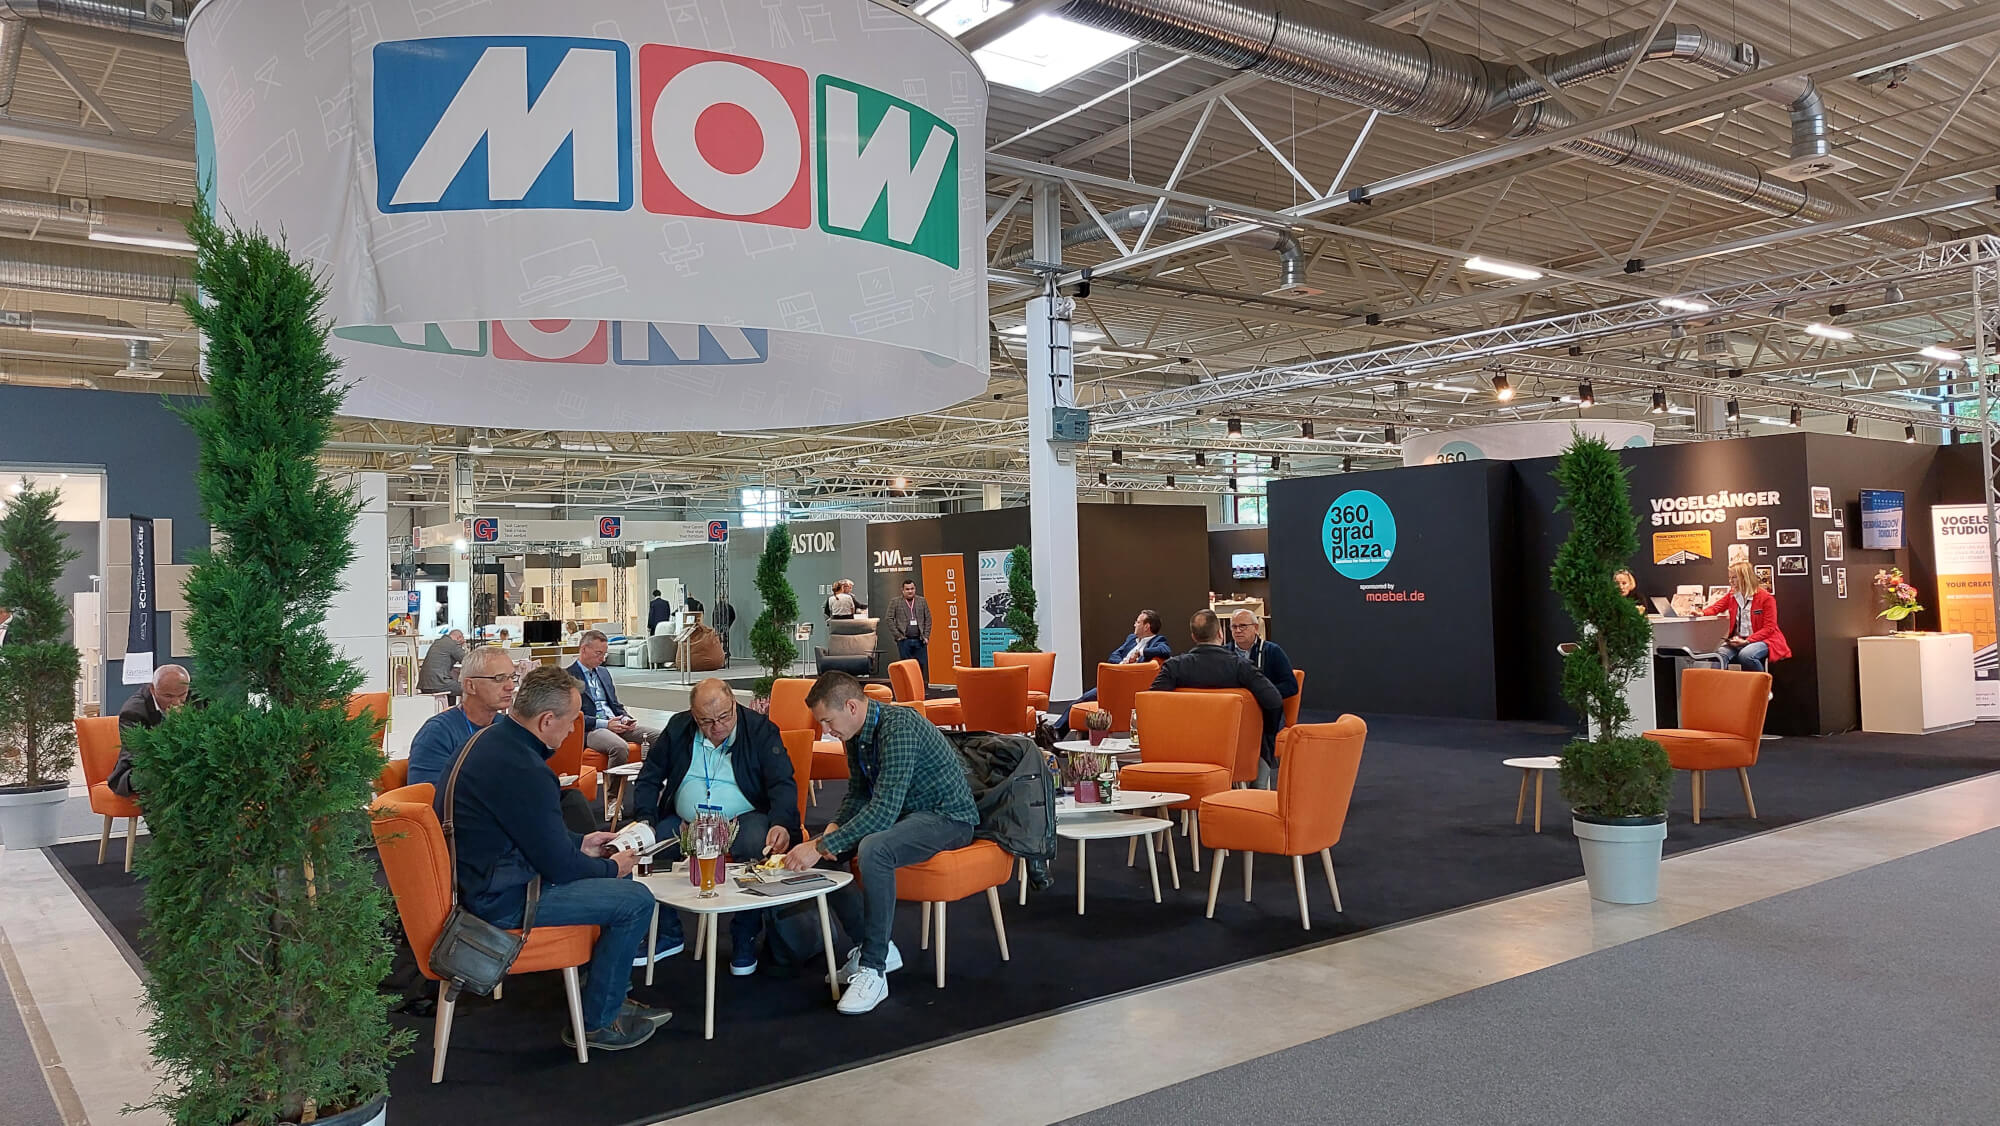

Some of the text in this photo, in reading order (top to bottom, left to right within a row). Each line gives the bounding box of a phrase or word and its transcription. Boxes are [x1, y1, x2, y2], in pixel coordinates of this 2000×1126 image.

[389, 46, 955, 245] MOW
[1650, 490, 1781, 512] VOGELSÄNGER
[1330, 504, 1369, 524] 360
[1651, 508, 1727, 526] STUDIOS
[1941, 515, 1989, 525] VOGELS
[1331, 520, 1374, 544] grad
[1941, 525, 1988, 536] STUDIO
[1366, 590, 1425, 602] moebel.de
[945, 568, 962, 667] moebel.de
